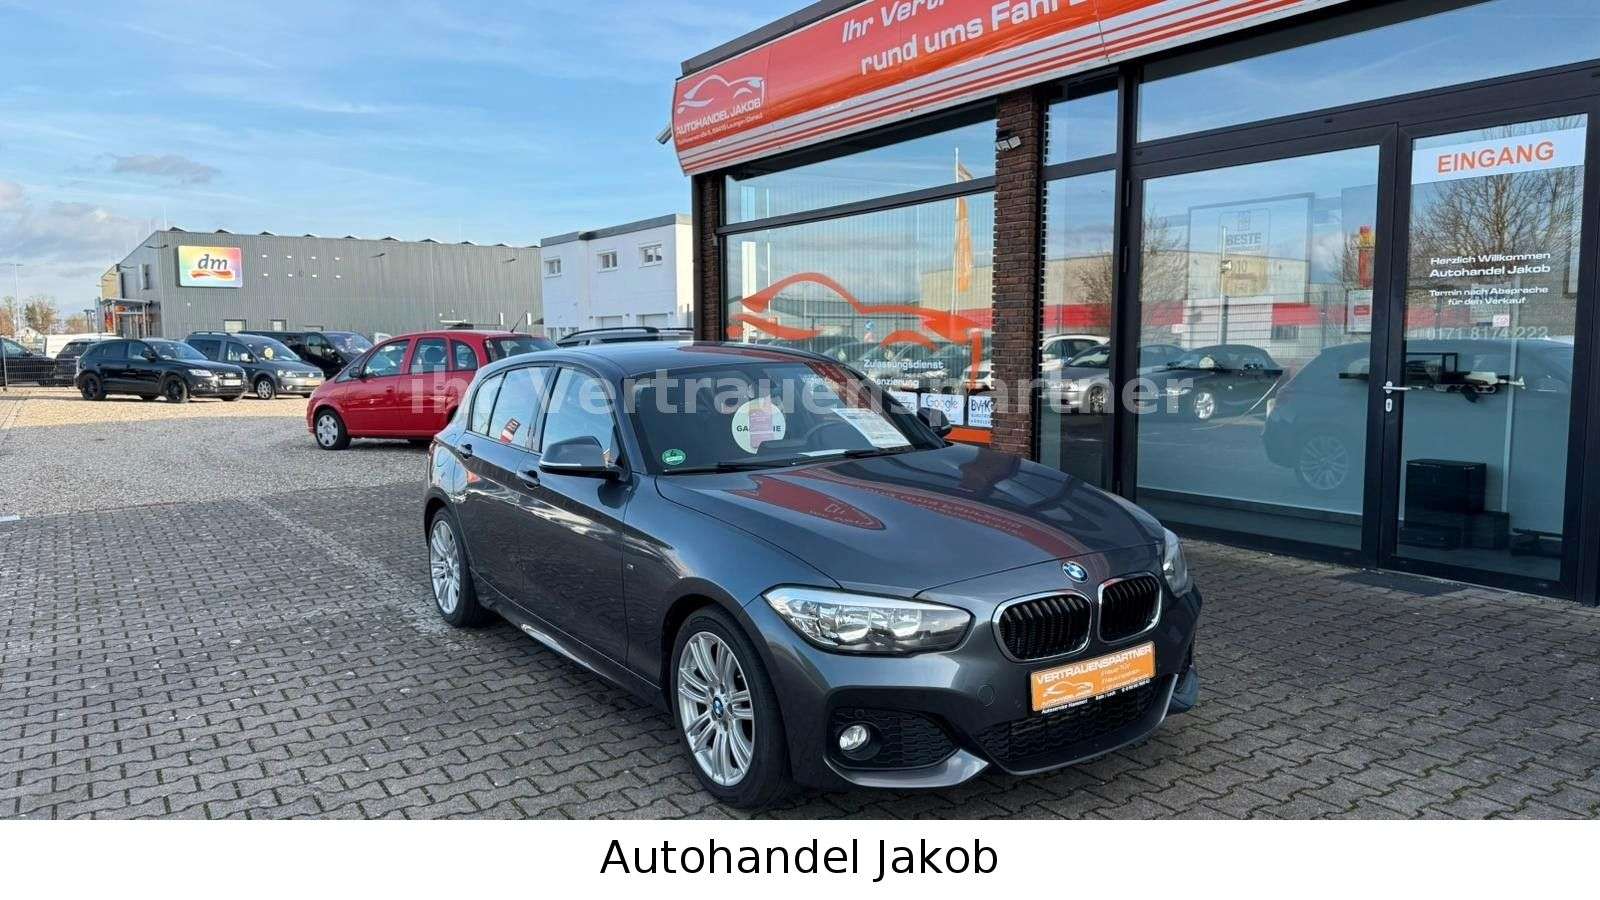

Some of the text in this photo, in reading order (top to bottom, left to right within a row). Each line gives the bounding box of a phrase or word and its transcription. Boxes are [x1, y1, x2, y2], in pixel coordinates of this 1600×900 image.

[841, 0, 944, 43] Ihr Vert
[860, 34, 918, 75] rund
[924, 17, 983, 54] ums
[676, 110, 730, 135] AUTOHANDEL
[731, 97, 761, 118] JAKOB
[1438, 141, 1554, 173] EINGANG
[1226, 232, 1262, 246] BESTE
[198, 253, 228, 270] dm
[1430, 252, 1551, 266] Herzlich Willkommen
[1429, 264, 1551, 278] Autohandel Jakob
[1429, 286, 1549, 297] Termin nach Absprache
[1448, 297, 1526, 306] für den Verkauf
[863, 359, 944, 370] Zulassungsdienst
[925, 393, 960, 412] Google
[1037, 646, 1151, 685] VERTRAUENSPARTNER
